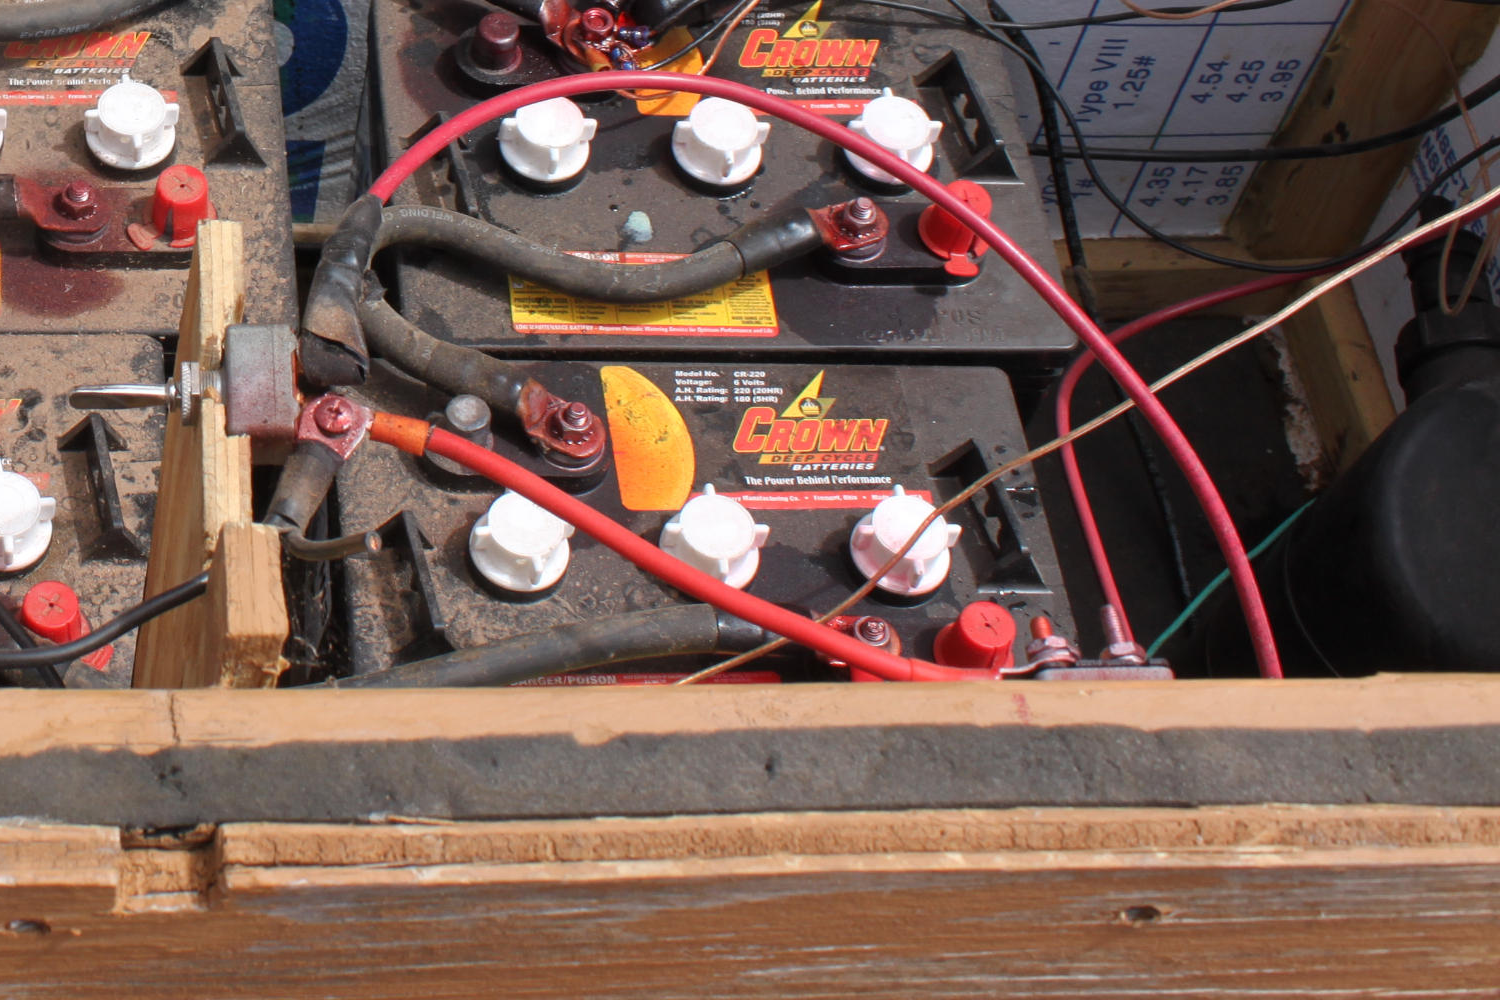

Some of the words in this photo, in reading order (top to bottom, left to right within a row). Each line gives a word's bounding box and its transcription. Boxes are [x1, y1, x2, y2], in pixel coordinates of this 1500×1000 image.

[738, 28, 881, 68] CROWN
[1113, 54, 1157, 111] 1.25#
[1190, 60, 1231, 104] 4.54
[1226, 59, 1267, 103] 4.25
[1259, 58, 1301, 102] 3.95
[1137, 165, 1178, 209] 4.35
[1173, 166, 1210, 208] 4.17
[1205, 164, 1246, 206] 3.85
[732, 406, 890, 453] CROWN
[745, 476, 762, 485] The
[764, 476, 795, 485] Power
[797, 476, 830, 485] Behind
[832, 475, 891, 485] Performance
[771, 455, 817, 463] DEEP
[821, 454, 874, 462] CYCLE
[791, 463, 875, 471] BATTERIES
